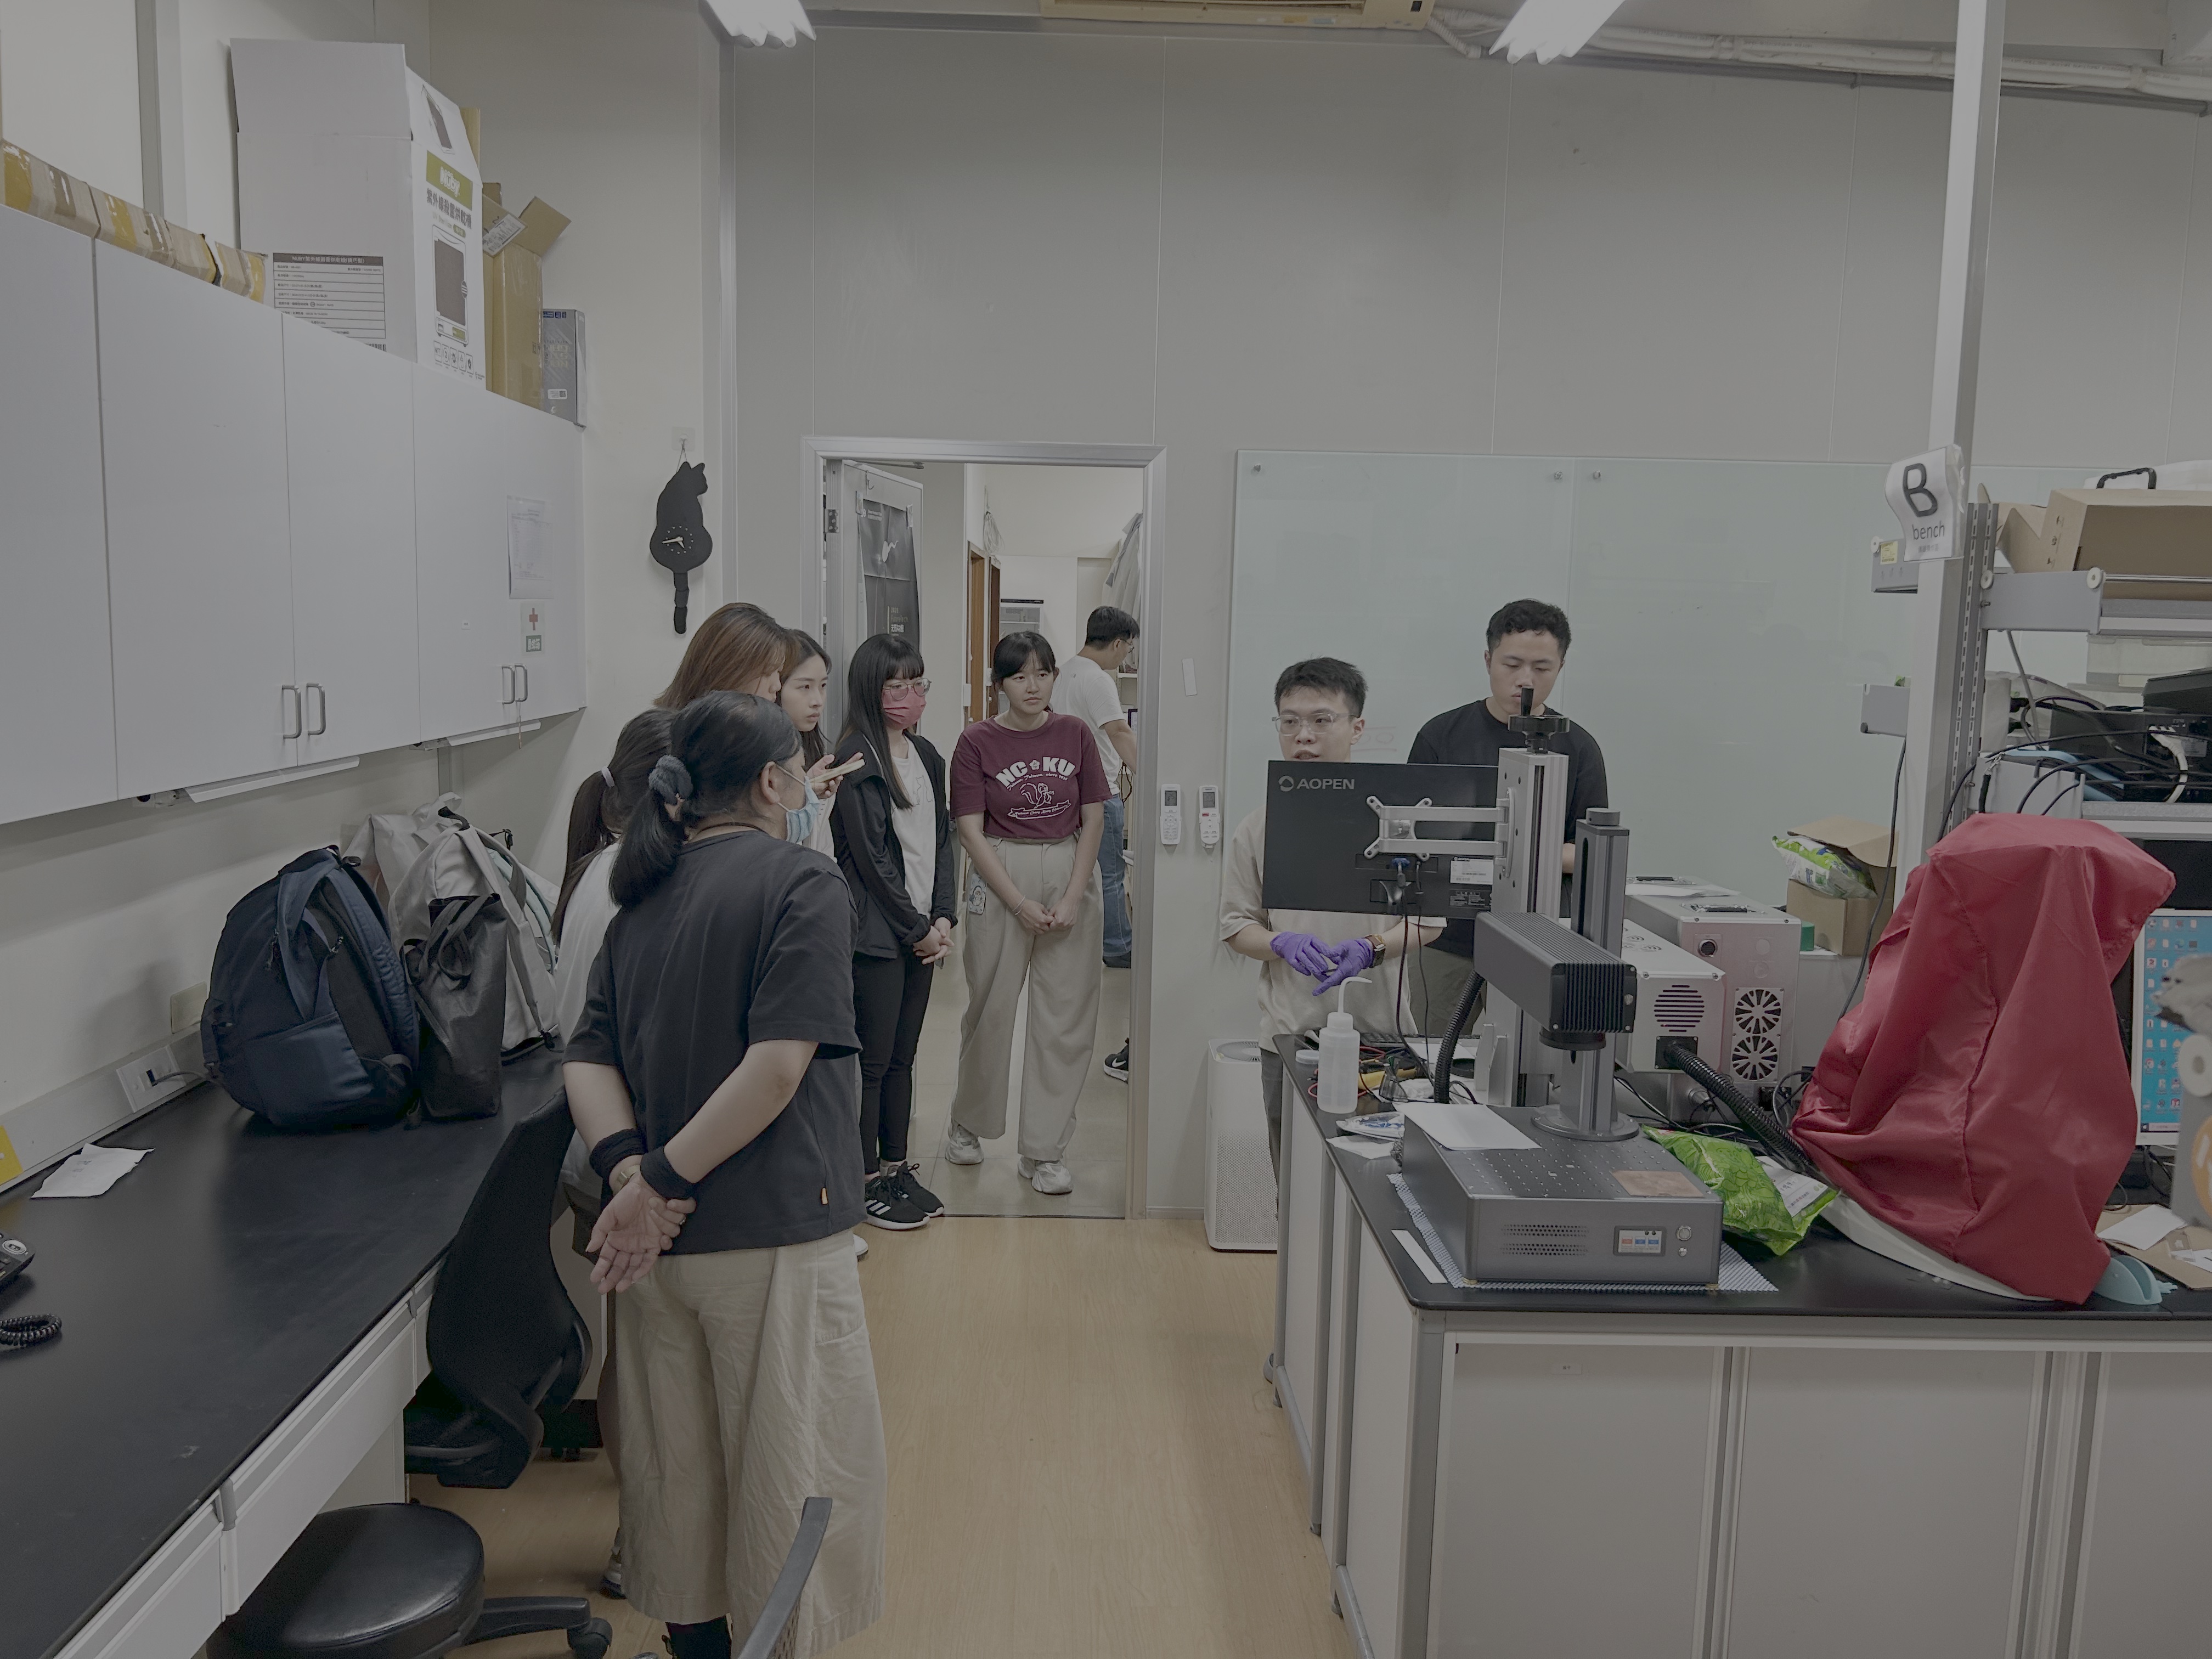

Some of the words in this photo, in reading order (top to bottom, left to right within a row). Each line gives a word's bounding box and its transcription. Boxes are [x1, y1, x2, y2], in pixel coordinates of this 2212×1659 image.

[1902, 462, 1938, 518] B
[1912, 520, 1945, 540] bench
[995, 761, 1028, 787] NC
[1042, 756, 1076, 776] KU
[1296, 778, 1355, 790] AOPEN
